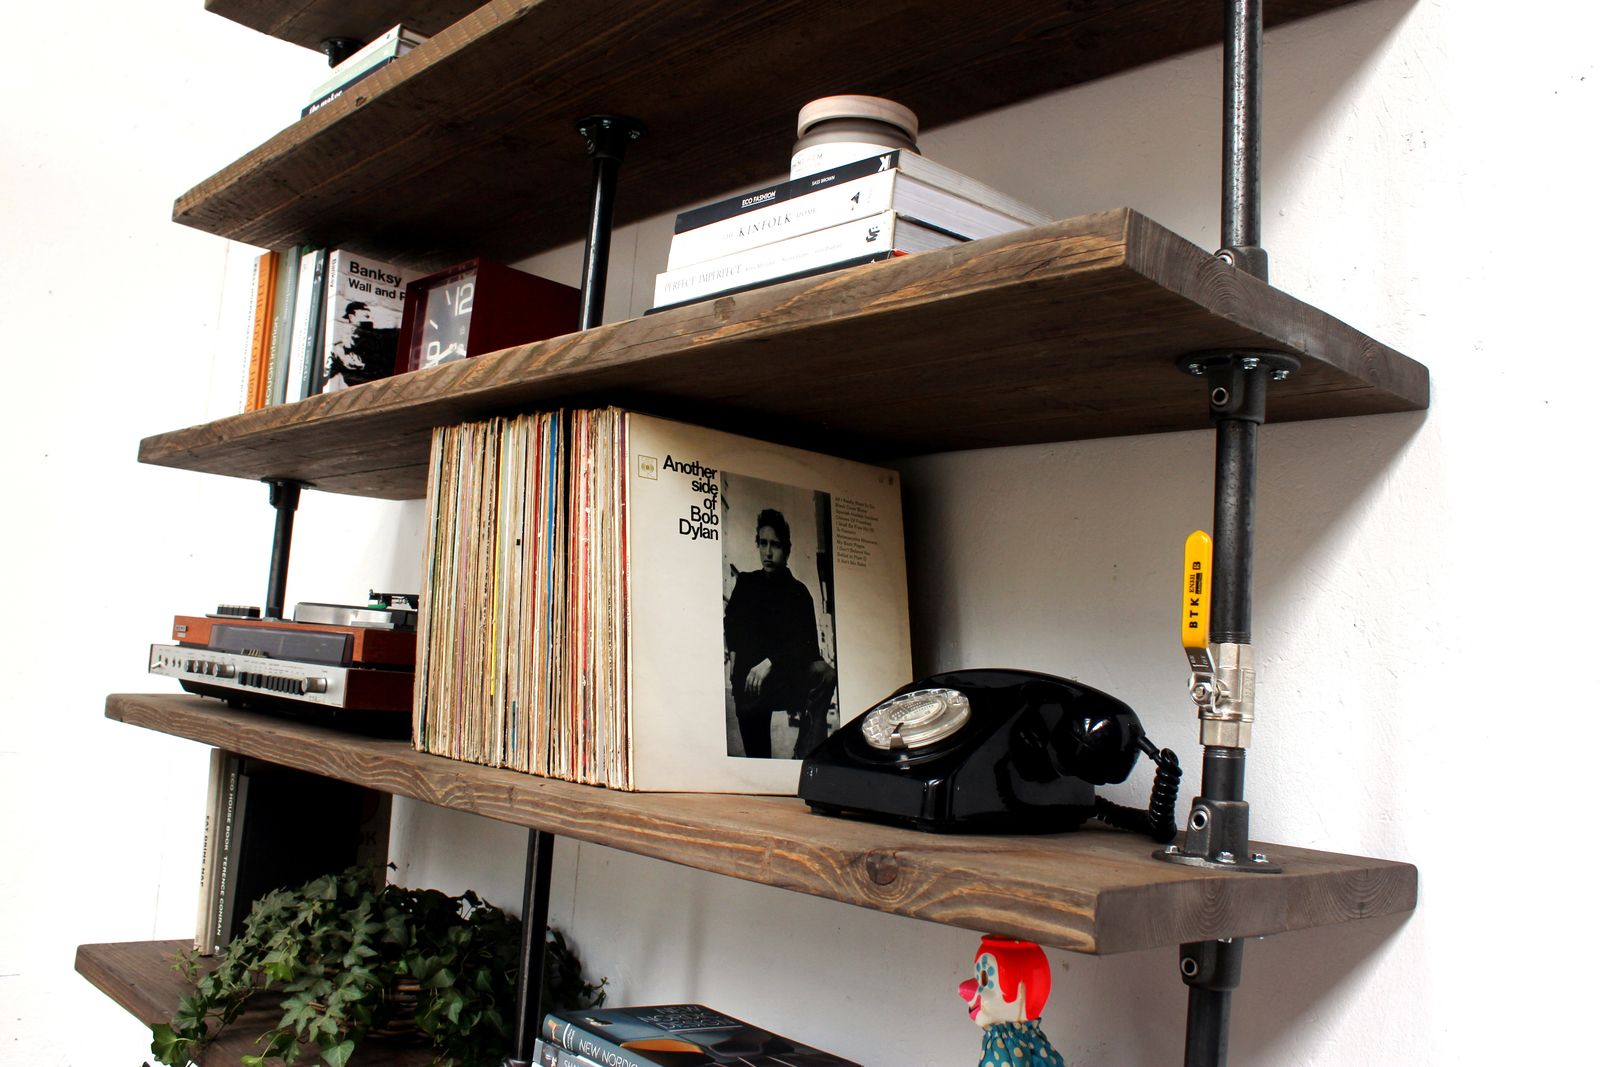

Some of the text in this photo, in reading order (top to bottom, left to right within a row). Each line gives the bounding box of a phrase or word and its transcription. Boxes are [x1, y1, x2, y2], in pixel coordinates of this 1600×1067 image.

[742, 197, 753, 207] ECO
[753, 190, 777, 203] FASHION
[738, 213, 791, 237] KINFOLK
[350, 261, 402, 288] Banksy
[348, 277, 372, 293] Wall
[375, 287, 396, 299] and
[454, 282, 475, 317] 12
[663, 454, 718, 480] Another
[691, 477, 719, 495] side
[691, 505, 719, 525] Bob
[703, 494, 718, 510] of
[679, 518, 719, 541] Dylan
[226, 793, 234, 823] HOUSE
[223, 825, 231, 851] BOOK
[220, 856, 229, 896] TERENCE
[217, 897, 225, 936] CONRAN
[579, 1039, 638, 1067] NEW NORD
